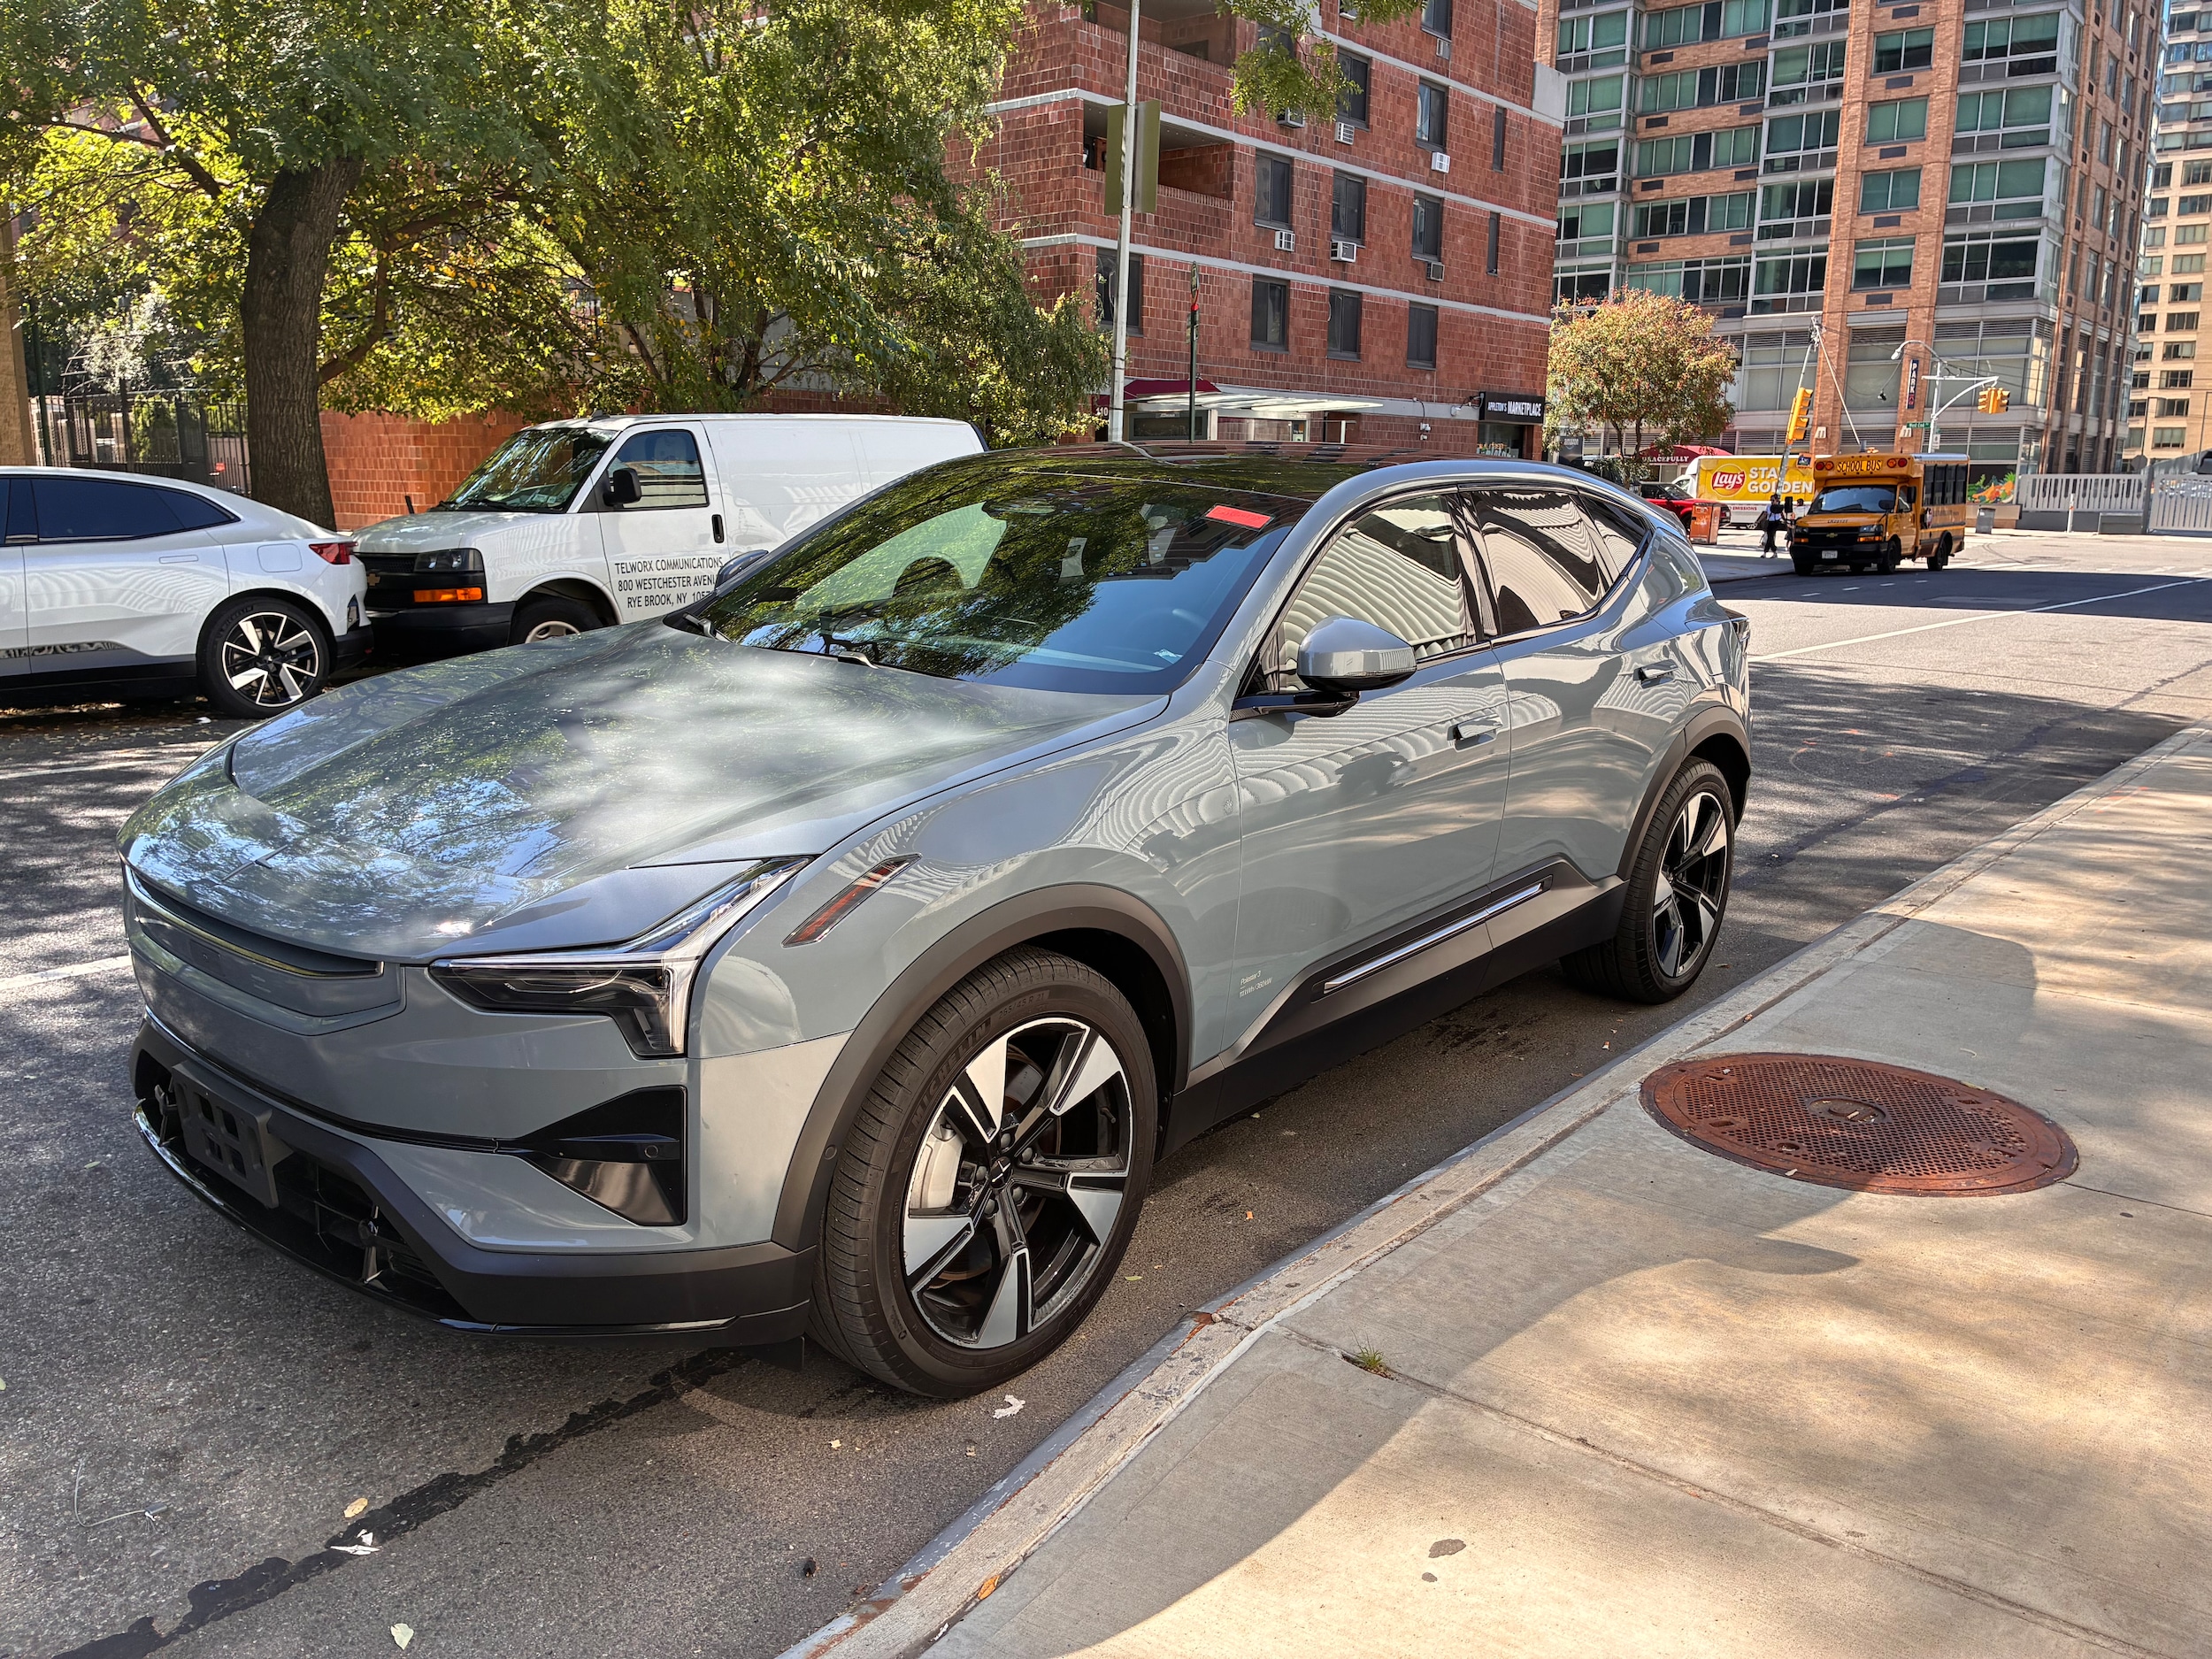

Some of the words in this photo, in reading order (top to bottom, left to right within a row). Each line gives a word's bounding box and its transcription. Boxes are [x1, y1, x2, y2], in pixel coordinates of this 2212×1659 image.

[1909, 363, 1918, 394] PARK
[1507, 401, 1542, 417] MARKETPLACE
[1749, 466, 1779, 479] STA
[1837, 460, 1864, 472] SCHOOL
[1866, 459, 1882, 471] BUS
[1713, 471, 1745, 489] Lay's
[615, 560, 654, 575] TELWORX
[655, 557, 724, 572] COMMUNICATIONS
[618, 580, 634, 592] 800
[635, 576, 692, 591] WESTCHESTER
[627, 595, 642, 609] RYE
[644, 593, 674, 607] BROOK,
[676, 592, 687, 604] NY
[692, 590, 710, 602] 105
[1240, 972, 1257, 986] Polestar
[910, 1017, 991, 1129] MICHELIN
